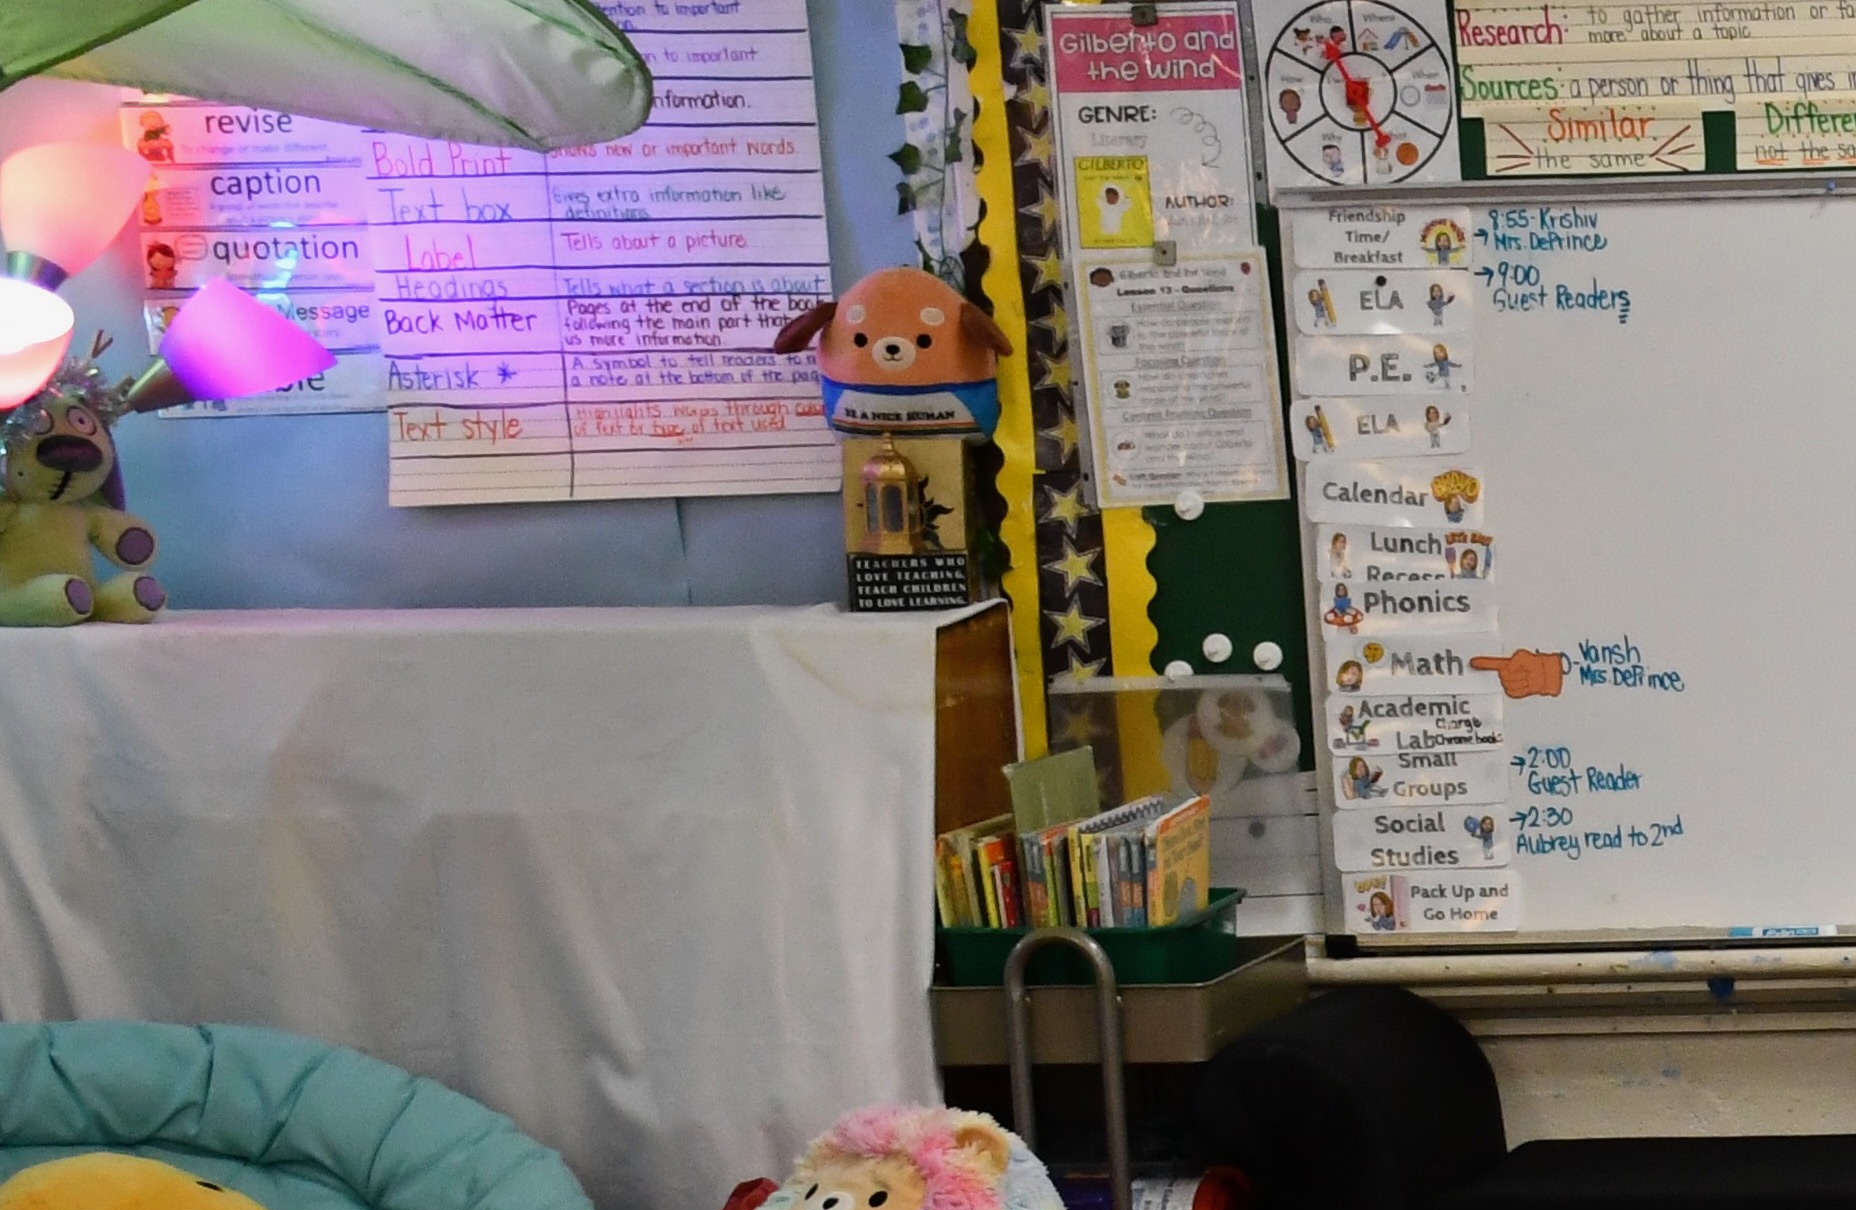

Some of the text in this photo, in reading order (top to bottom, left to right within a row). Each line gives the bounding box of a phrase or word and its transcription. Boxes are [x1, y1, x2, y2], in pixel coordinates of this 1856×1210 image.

[1456, 4, 1569, 46] Research:
[1589, 6, 1607, 25] to
[1623, 5, 1681, 33] gather
[1698, 1, 1796, 24] information
[1810, 5, 1828, 19] or
[1588, 25, 1751, 43] more about a topic
[1059, 27, 1235, 53] Gilberto and
[1088, 60, 1139, 82] the
[1460, 65, 1565, 101] Sources:
[1570, 78, 1582, 98] a
[1589, 76, 1649, 105] person
[1660, 77, 1680, 96] or
[1687, 58, 1736, 104] thing
[1743, 56, 1785, 93] that
[1796, 67, 1836, 99] gives
[205, 108, 293, 133] revise
[1078, 105, 1157, 124] GENRE:
[1547, 107, 1655, 141] Similar
[372, 141, 512, 176] Bold Print
[1534, 147, 1646, 169] the same
[1754, 141, 1787, 160] not
[1800, 141, 1830, 159] the
[210, 167, 321, 201] caption
[378, 188, 443, 223] Text
[462, 187, 513, 222] box
[1328, 208, 1406, 224] Friendship
[561, 229, 747, 253] Tells about a picture
[1345, 230, 1389, 244] Time/
[1530, 231, 1608, 251] DePrince
[213, 234, 359, 264] quotation
[405, 234, 476, 271] Label
[1334, 251, 1403, 264] Breakfast
[1498, 262, 1540, 287] 9:00
[395, 275, 508, 298] Headings
[1493, 277, 1631, 312] Guest Readers
[1360, 289, 1404, 311] ELA
[384, 300, 537, 335] Back Matter
[388, 361, 479, 390] Asterisk
[1350, 353, 1412, 382] P.E.
[393, 408, 523, 446] Text style
[1357, 413, 1400, 435] ELA
[1323, 481, 1429, 507] Calendar
[1370, 532, 1442, 555] Lunch
[856, 557, 965, 570] TEACHERS WHO
[856, 571, 889, 582] LOVE
[857, 583, 967, 595] TEACH CHILDREN
[858, 598, 873, 608] TO
[877, 597, 905, 608] LOVE
[1364, 589, 1471, 614] Phonics
[1391, 649, 1464, 676] Math
[1358, 695, 1471, 719] Academic
[1396, 730, 1436, 750] Lab
[1399, 752, 1458, 768] Small
[1393, 781, 1468, 800] Groups
[1528, 763, 1642, 797] Guest Reader
[1375, 812, 1445, 834] Social
[1526, 806, 1573, 827] 2:30
[1517, 833, 1581, 860] Aubrey
[1584, 825, 1622, 849] read
[1628, 826, 1648, 846] to
[1371, 845, 1459, 867] Studies
[1410, 884, 1509, 902] Pack Up and
[1423, 907, 1498, 920] Go Home
